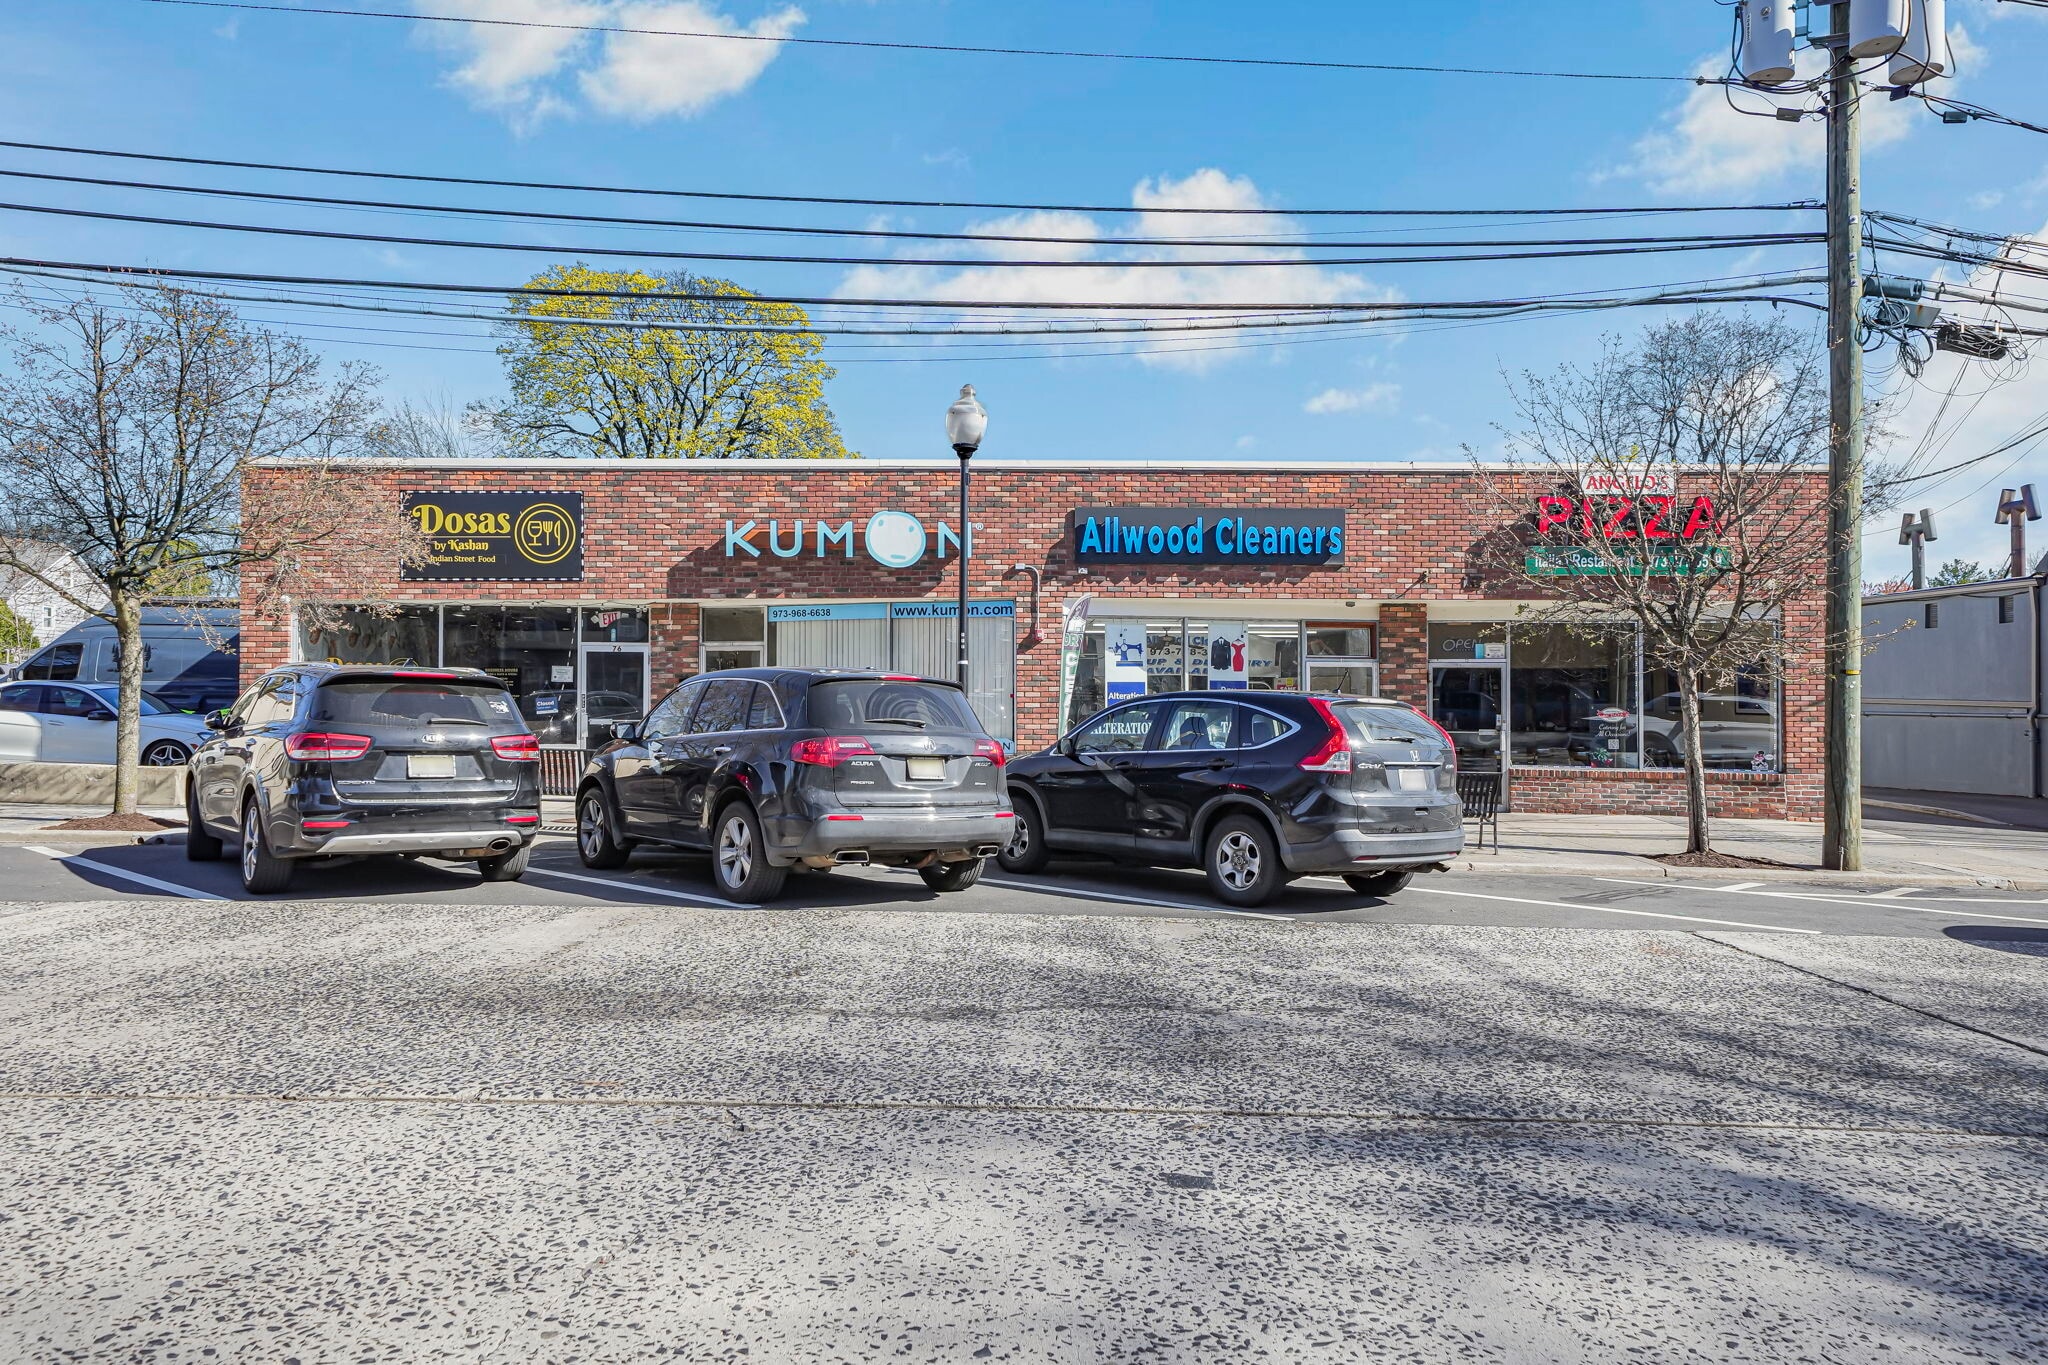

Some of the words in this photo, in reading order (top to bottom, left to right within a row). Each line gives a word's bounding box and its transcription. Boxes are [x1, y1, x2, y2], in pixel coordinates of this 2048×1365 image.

[412, 504, 511, 534] Dosas
[1538, 496, 1722, 539] PIZZA
[434, 541, 446, 552] by
[447, 539, 489, 552] Kashan
[725, 510, 972, 568] KUMON
[1080, 516, 1203, 554] Allwood
[1215, 517, 1342, 555] Cleaners
[602, 613, 618, 625] EXIT
[772, 608, 831, 618] 973-968-6638
